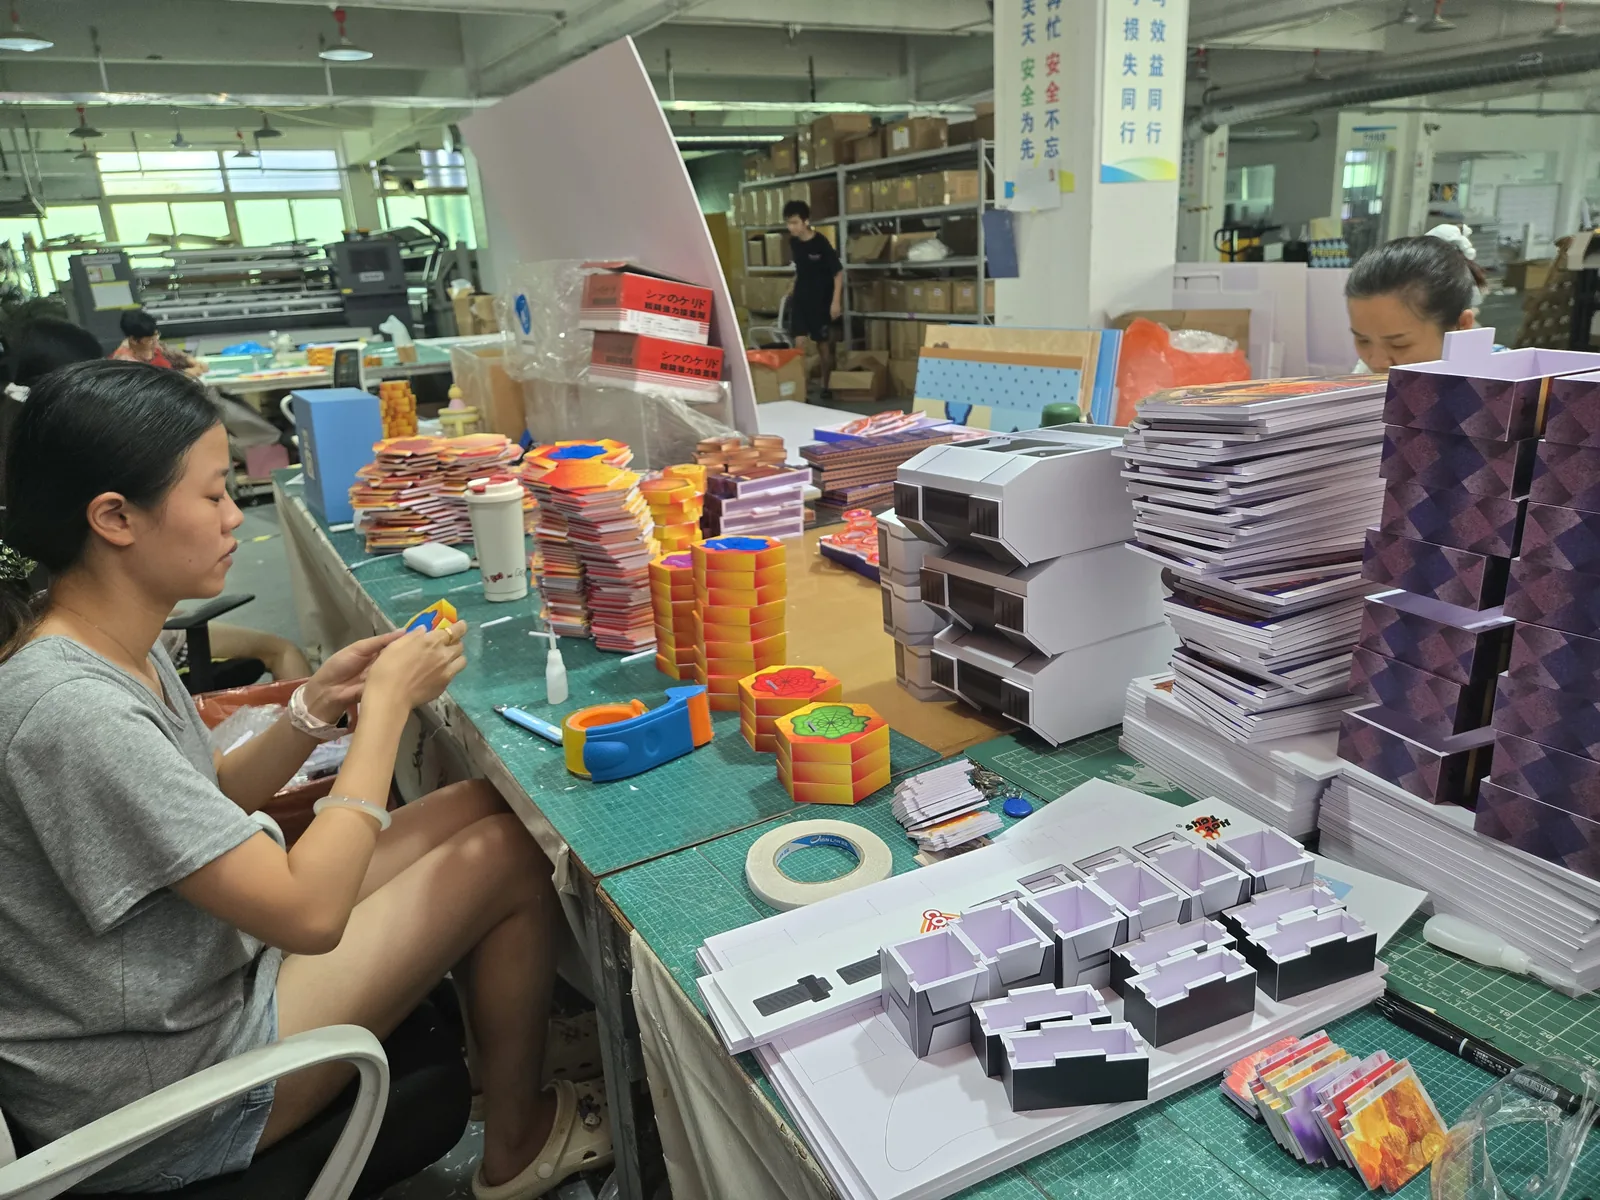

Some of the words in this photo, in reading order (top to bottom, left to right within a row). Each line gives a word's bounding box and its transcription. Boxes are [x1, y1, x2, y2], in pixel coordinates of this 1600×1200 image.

[1120, 0, 1139, 144] 损失同行
[1500, 1009, 1511, 1017] 19
[1540, 1030, 1553, 1039] 20
